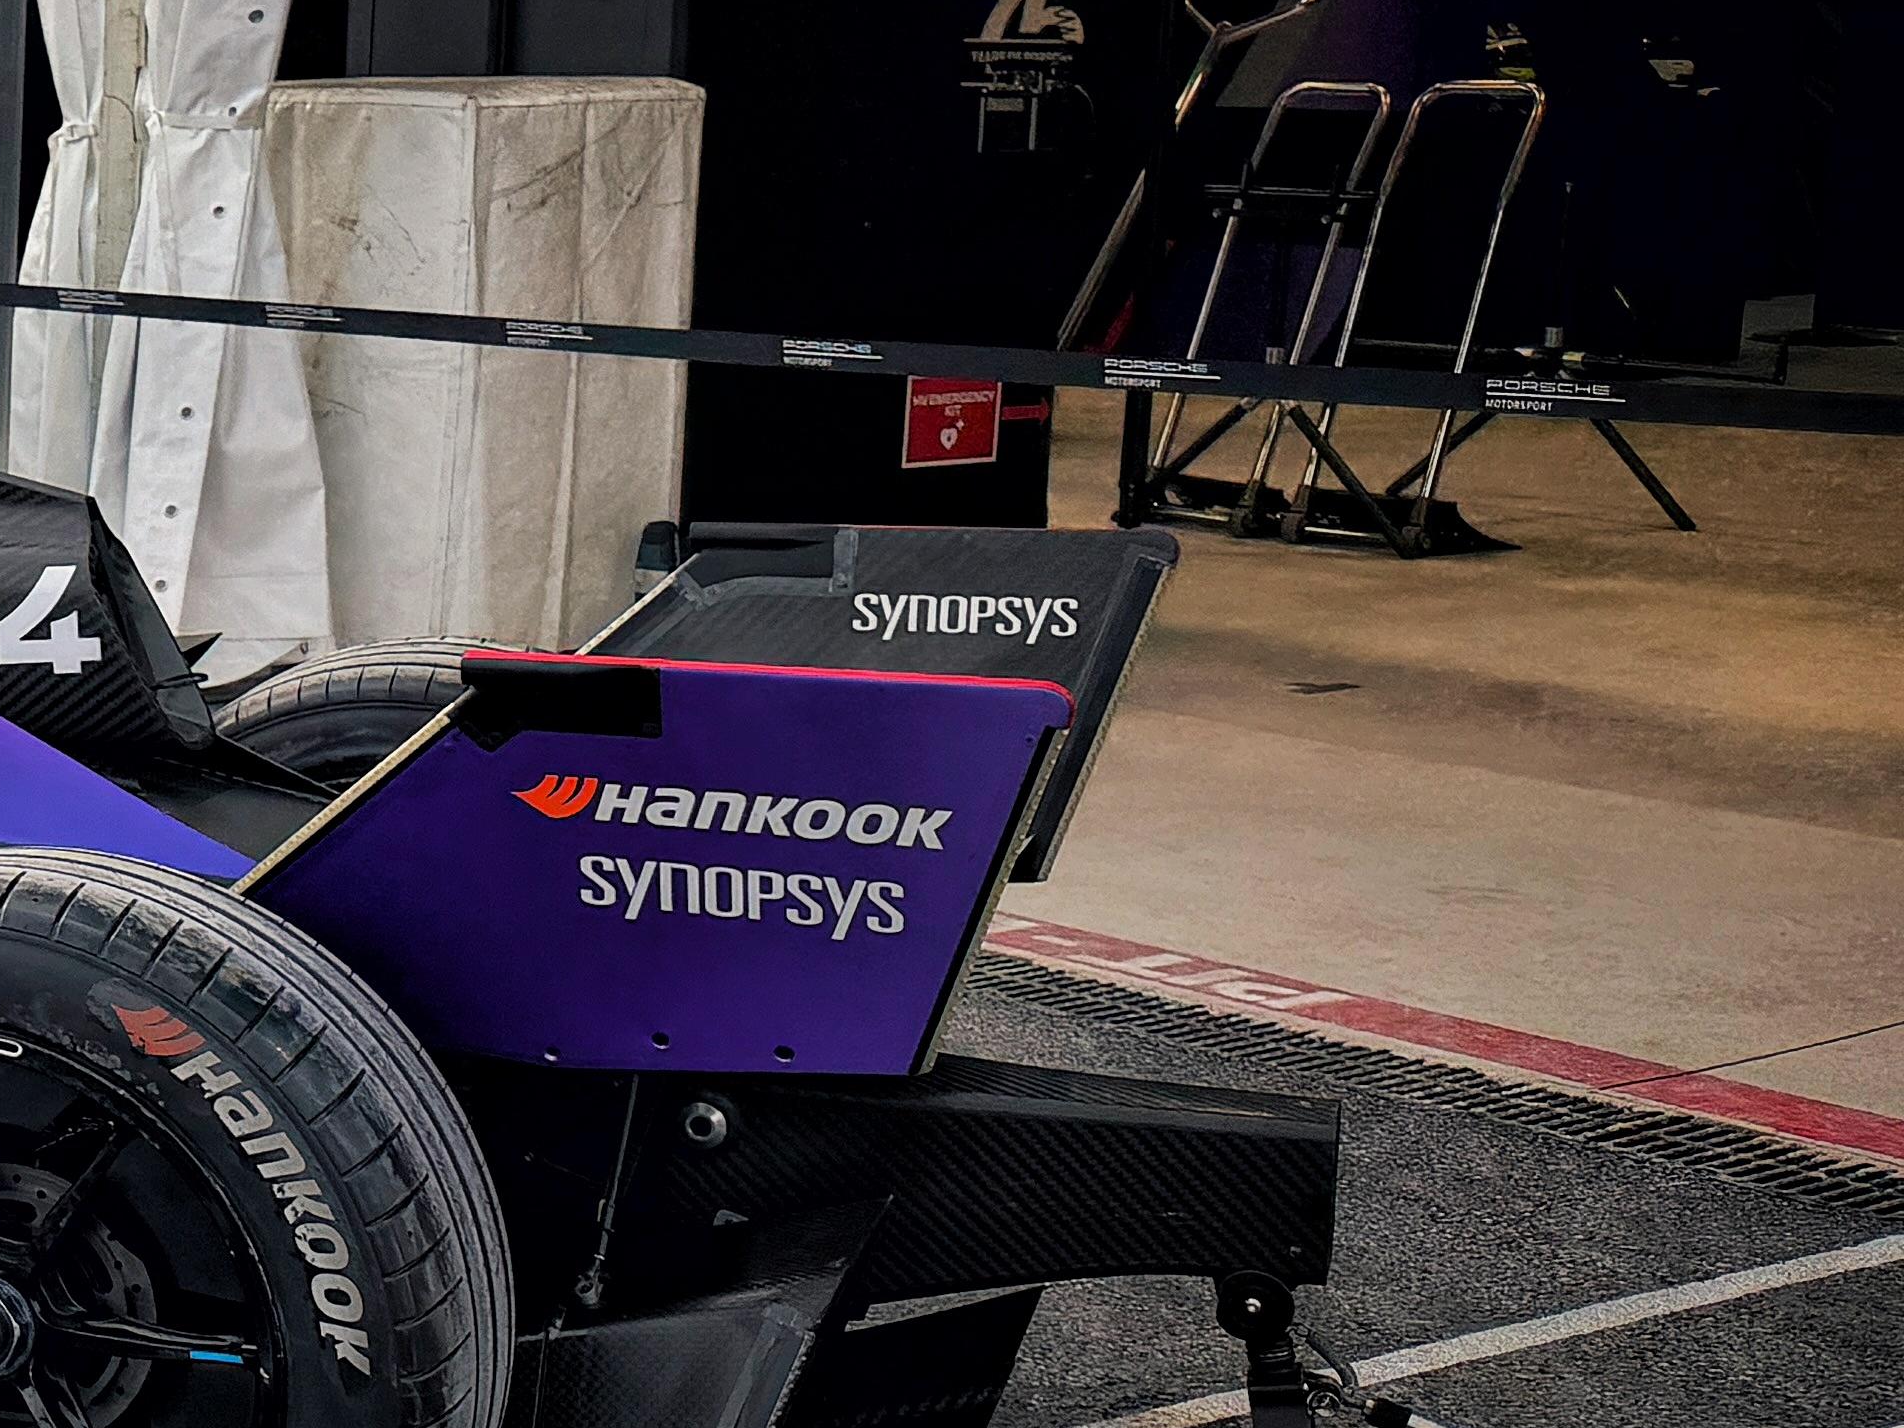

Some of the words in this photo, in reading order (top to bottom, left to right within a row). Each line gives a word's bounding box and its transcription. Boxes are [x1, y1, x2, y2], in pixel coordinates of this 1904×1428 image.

[782, 339, 873, 354] PORSCHE
[1104, 358, 1209, 374] PORSCHE
[1104, 375, 1162, 389] MOTORSPORT
[1486, 378, 1611, 396] PORSCHE
[1485, 400, 1554, 412] MOTORSPORT
[852, 592, 1079, 644] SYNOPSYS
[579, 854, 906, 941] SYNOPSYS
